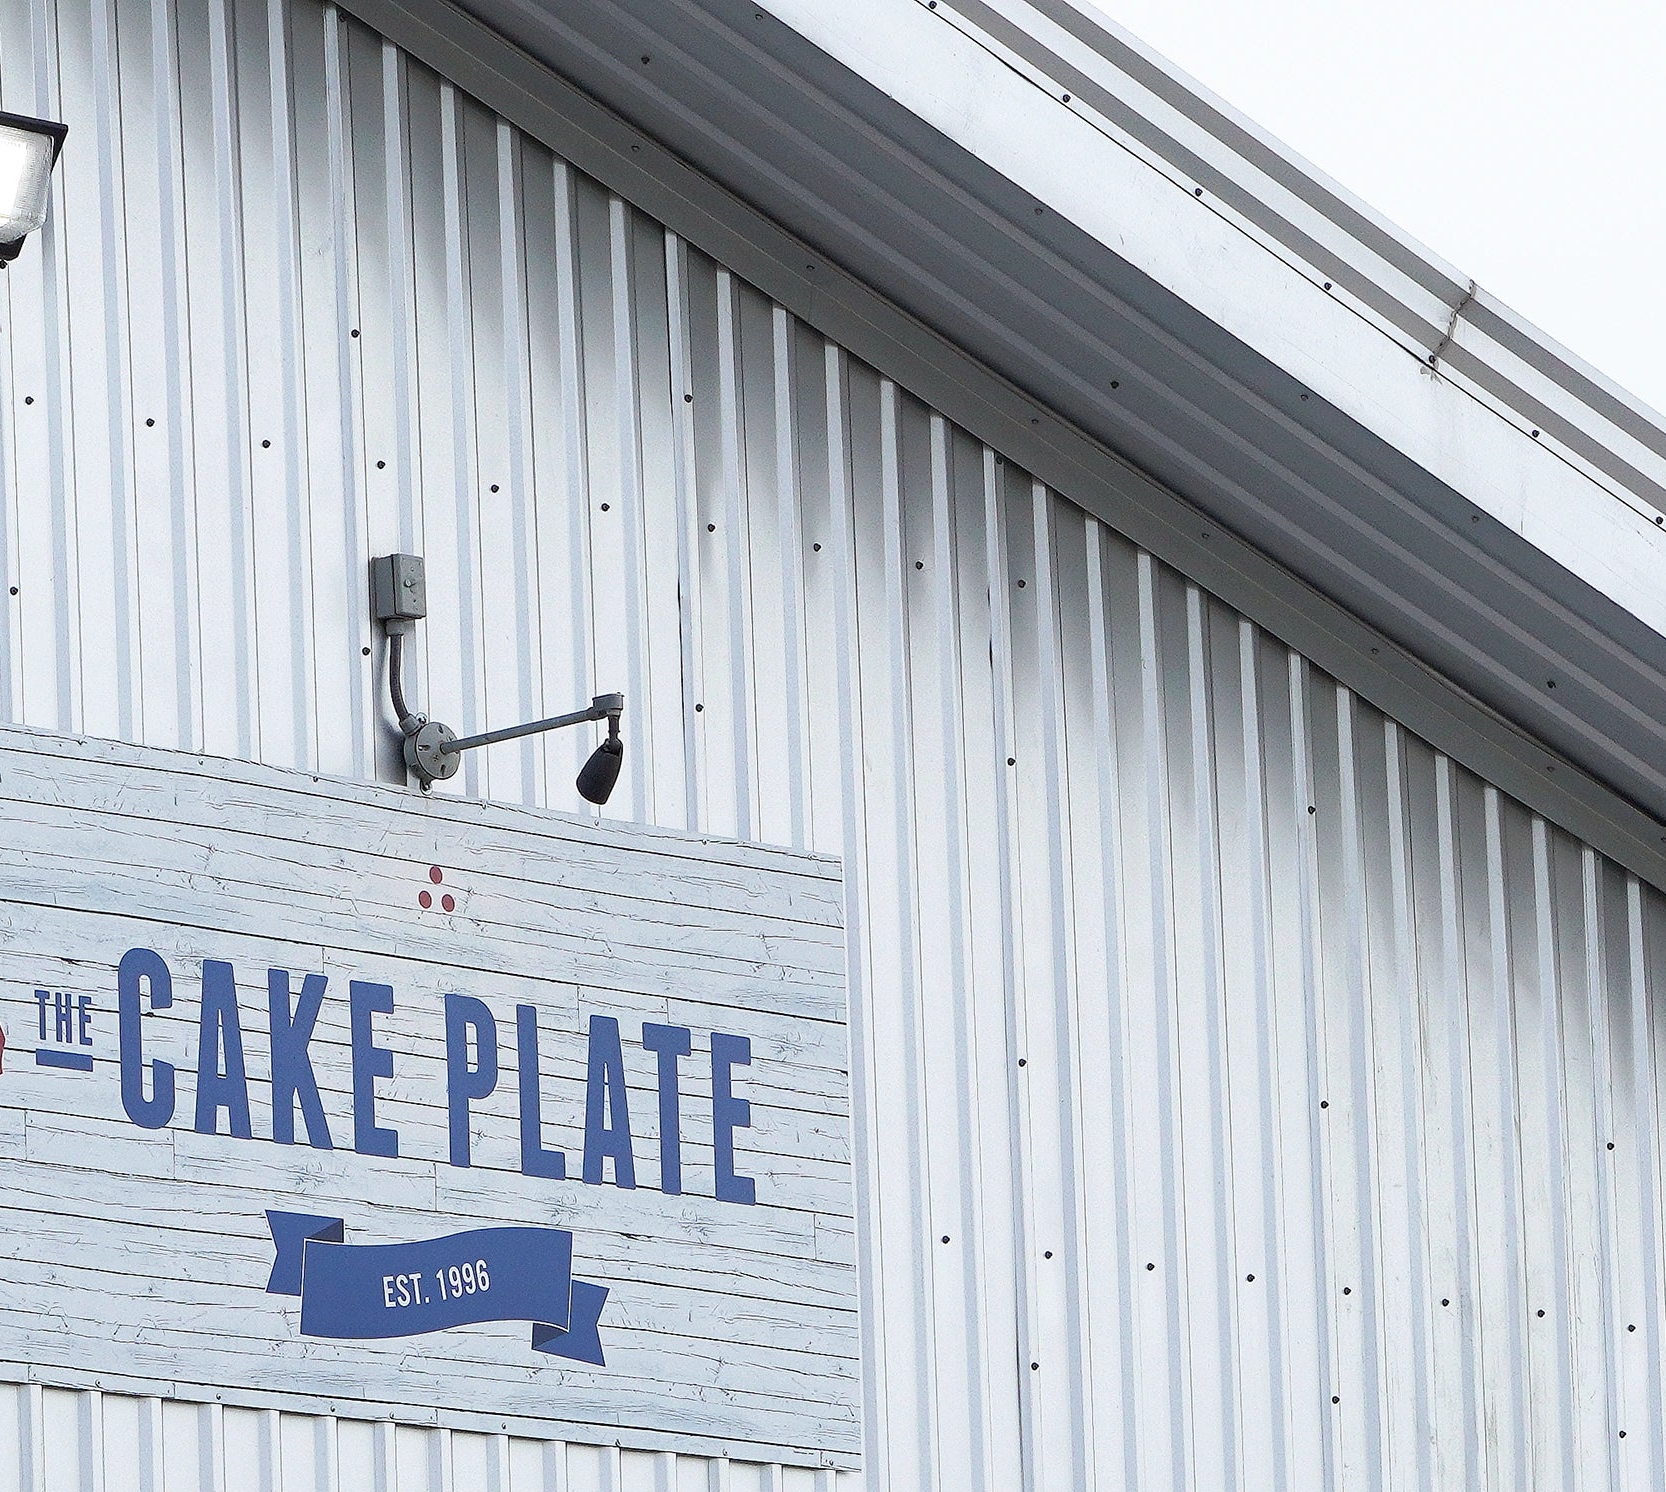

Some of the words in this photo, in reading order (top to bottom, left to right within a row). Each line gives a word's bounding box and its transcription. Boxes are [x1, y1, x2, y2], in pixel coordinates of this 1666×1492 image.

[34, 989, 93, 1048] THE
[117, 947, 399, 1158] CAKE
[443, 993, 756, 1206] PLATE
[382, 1272, 430, 1308] EST.
[436, 1259, 491, 1301] 1996
